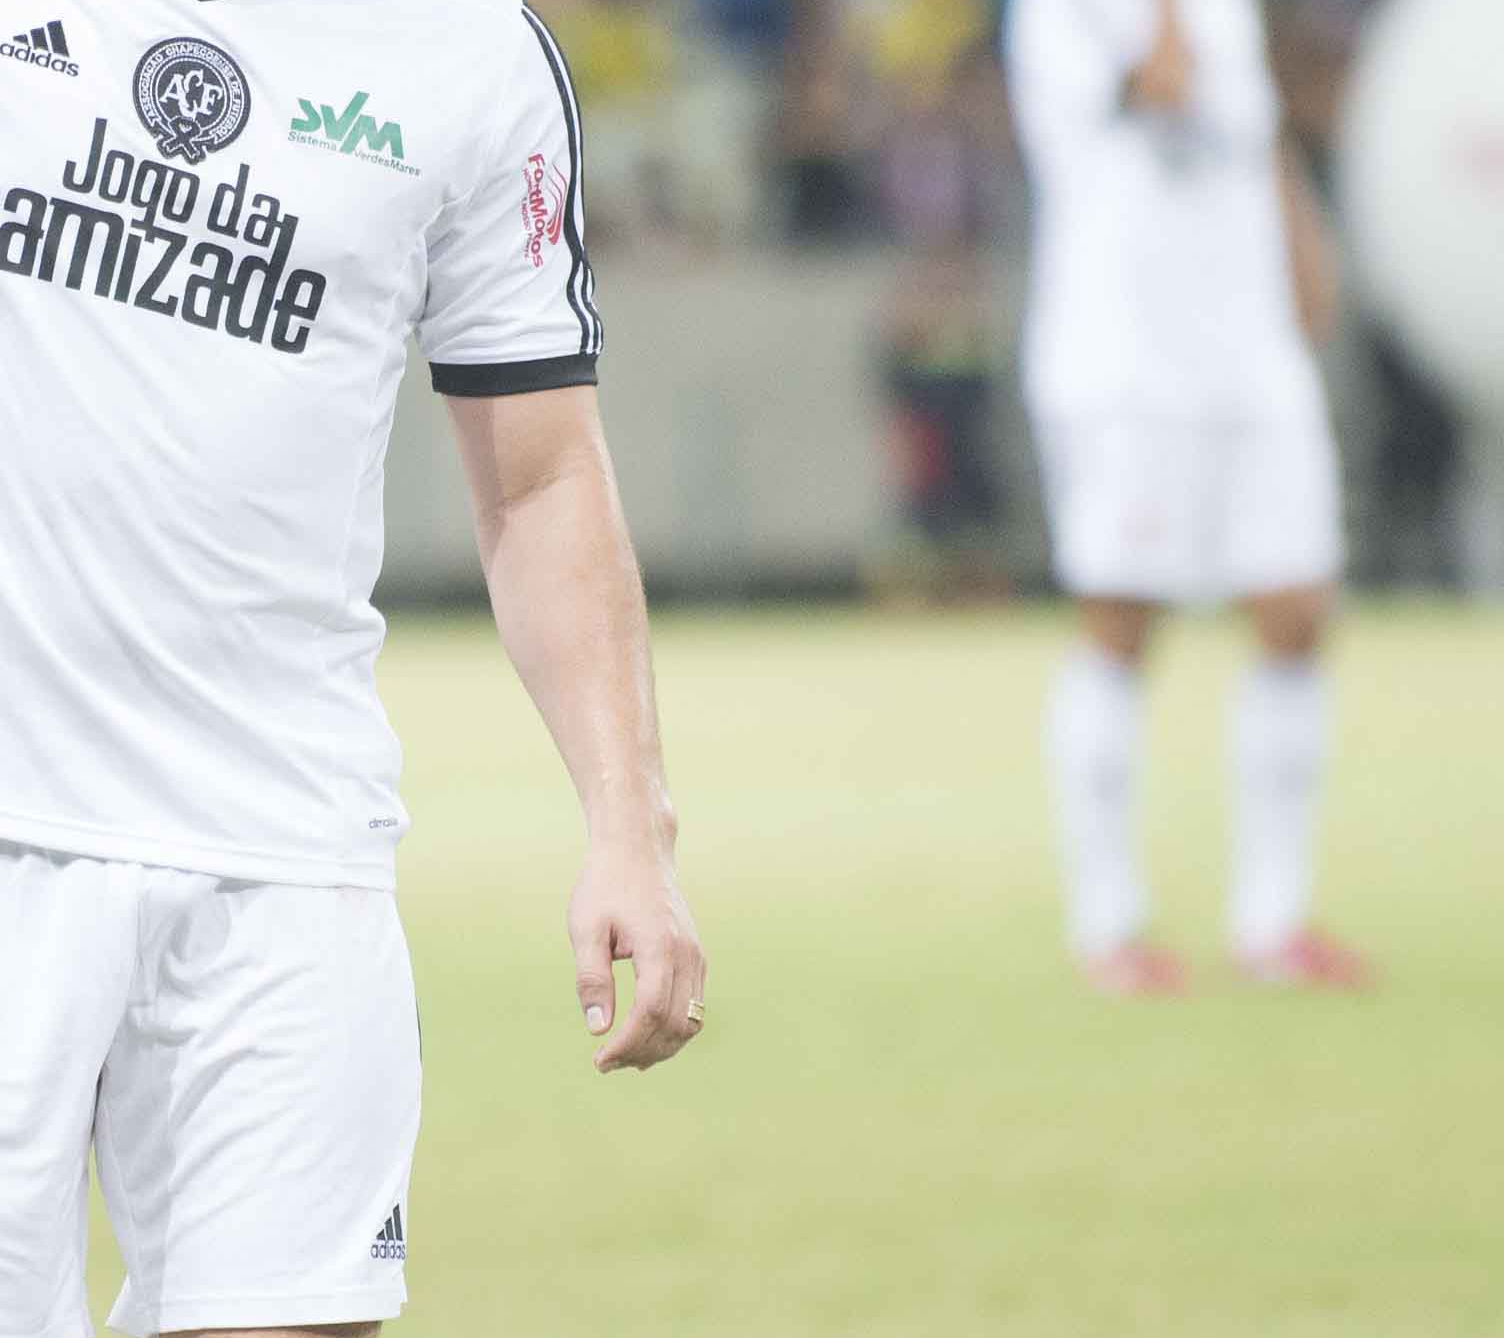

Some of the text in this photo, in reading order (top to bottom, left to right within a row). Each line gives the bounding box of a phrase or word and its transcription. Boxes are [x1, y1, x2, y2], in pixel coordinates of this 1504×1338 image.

[288, 131, 337, 152] Sistema
[291, 91, 404, 160] SVM
[62, 118, 281, 247] Jogo da
[528, 153, 548, 268] FortMotos
[369, 1238, 406, 1261] adidas
